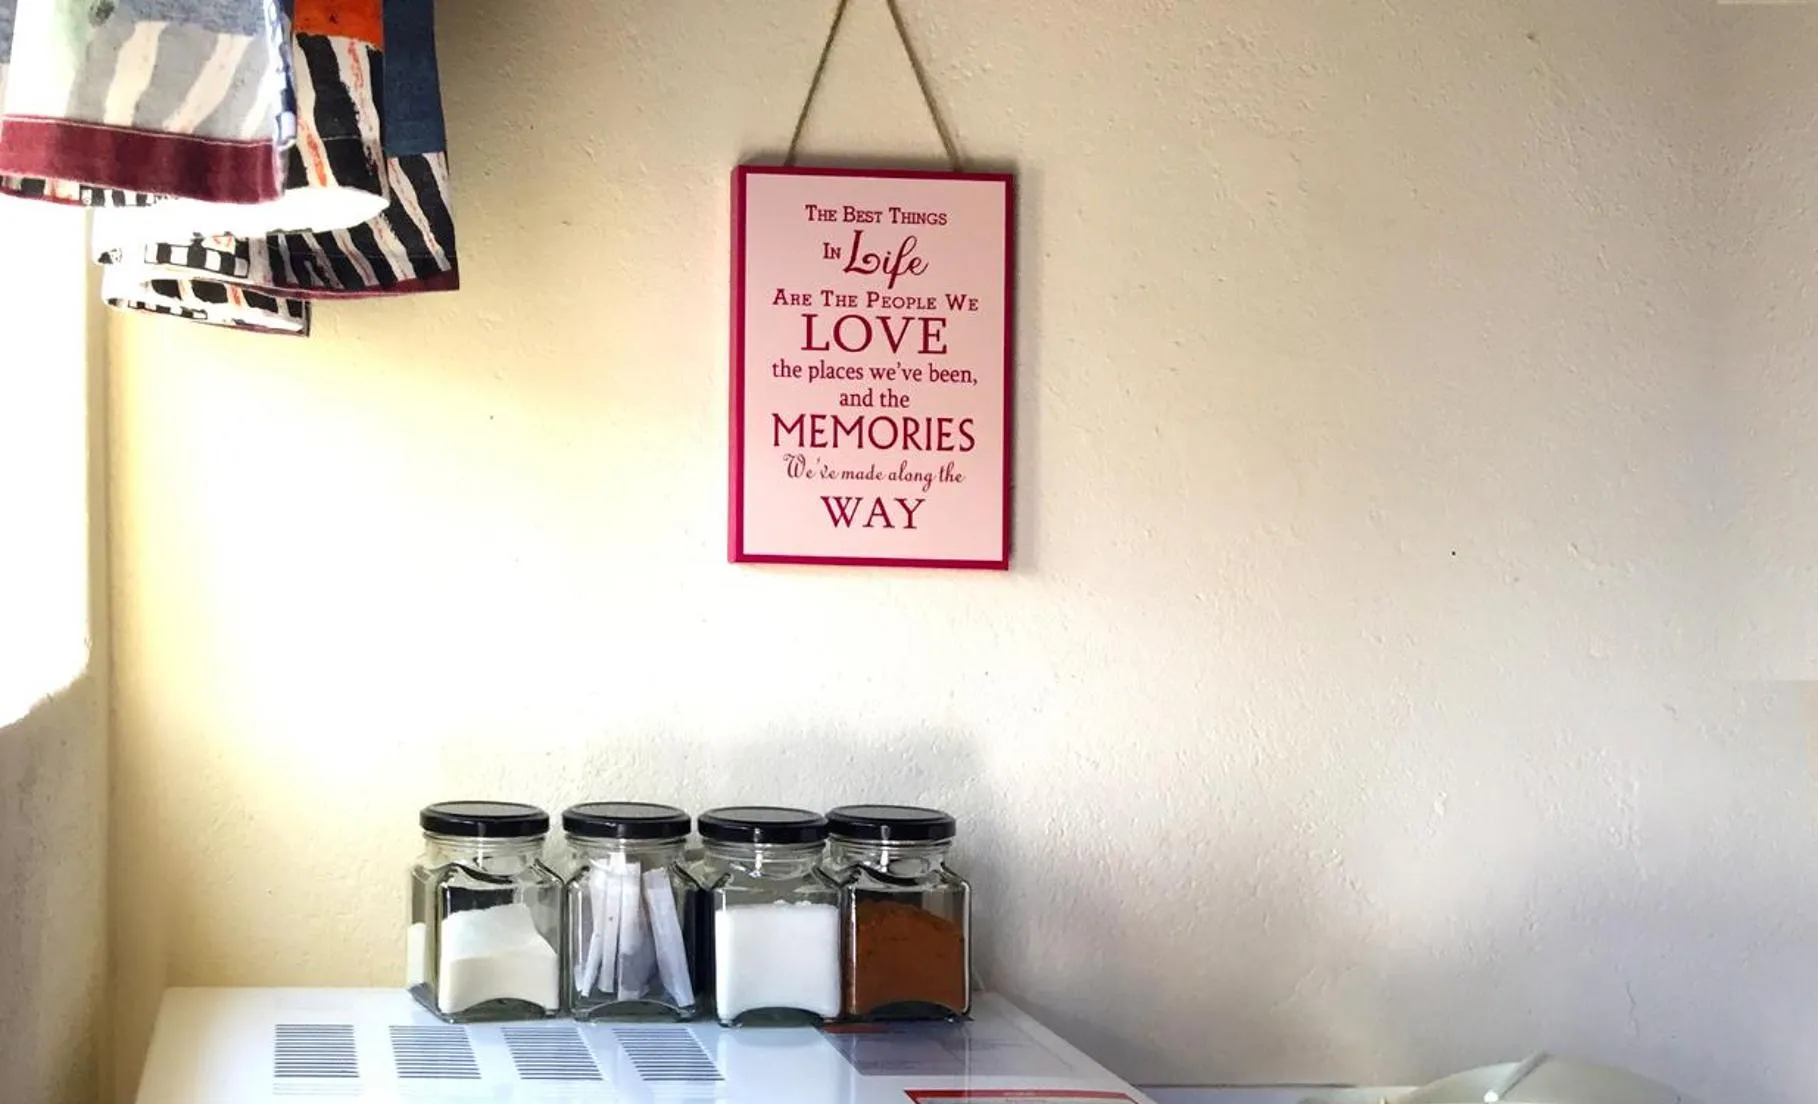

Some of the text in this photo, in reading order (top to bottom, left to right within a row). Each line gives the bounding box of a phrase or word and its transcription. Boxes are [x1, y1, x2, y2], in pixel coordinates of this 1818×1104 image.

[805, 204, 947, 226] THE BEST THINGS
[823, 230, 929, 289] IN Life
[773, 288, 978, 311] ARE THE PEOPLE WE
[801, 313, 948, 354] LOVE
[772, 359, 978, 385] the places we've been,
[839, 388, 910, 408] and the
[772, 413, 975, 452] MEMORIES
[783, 454, 966, 491] We've made along the
[820, 496, 926, 529] WAY
